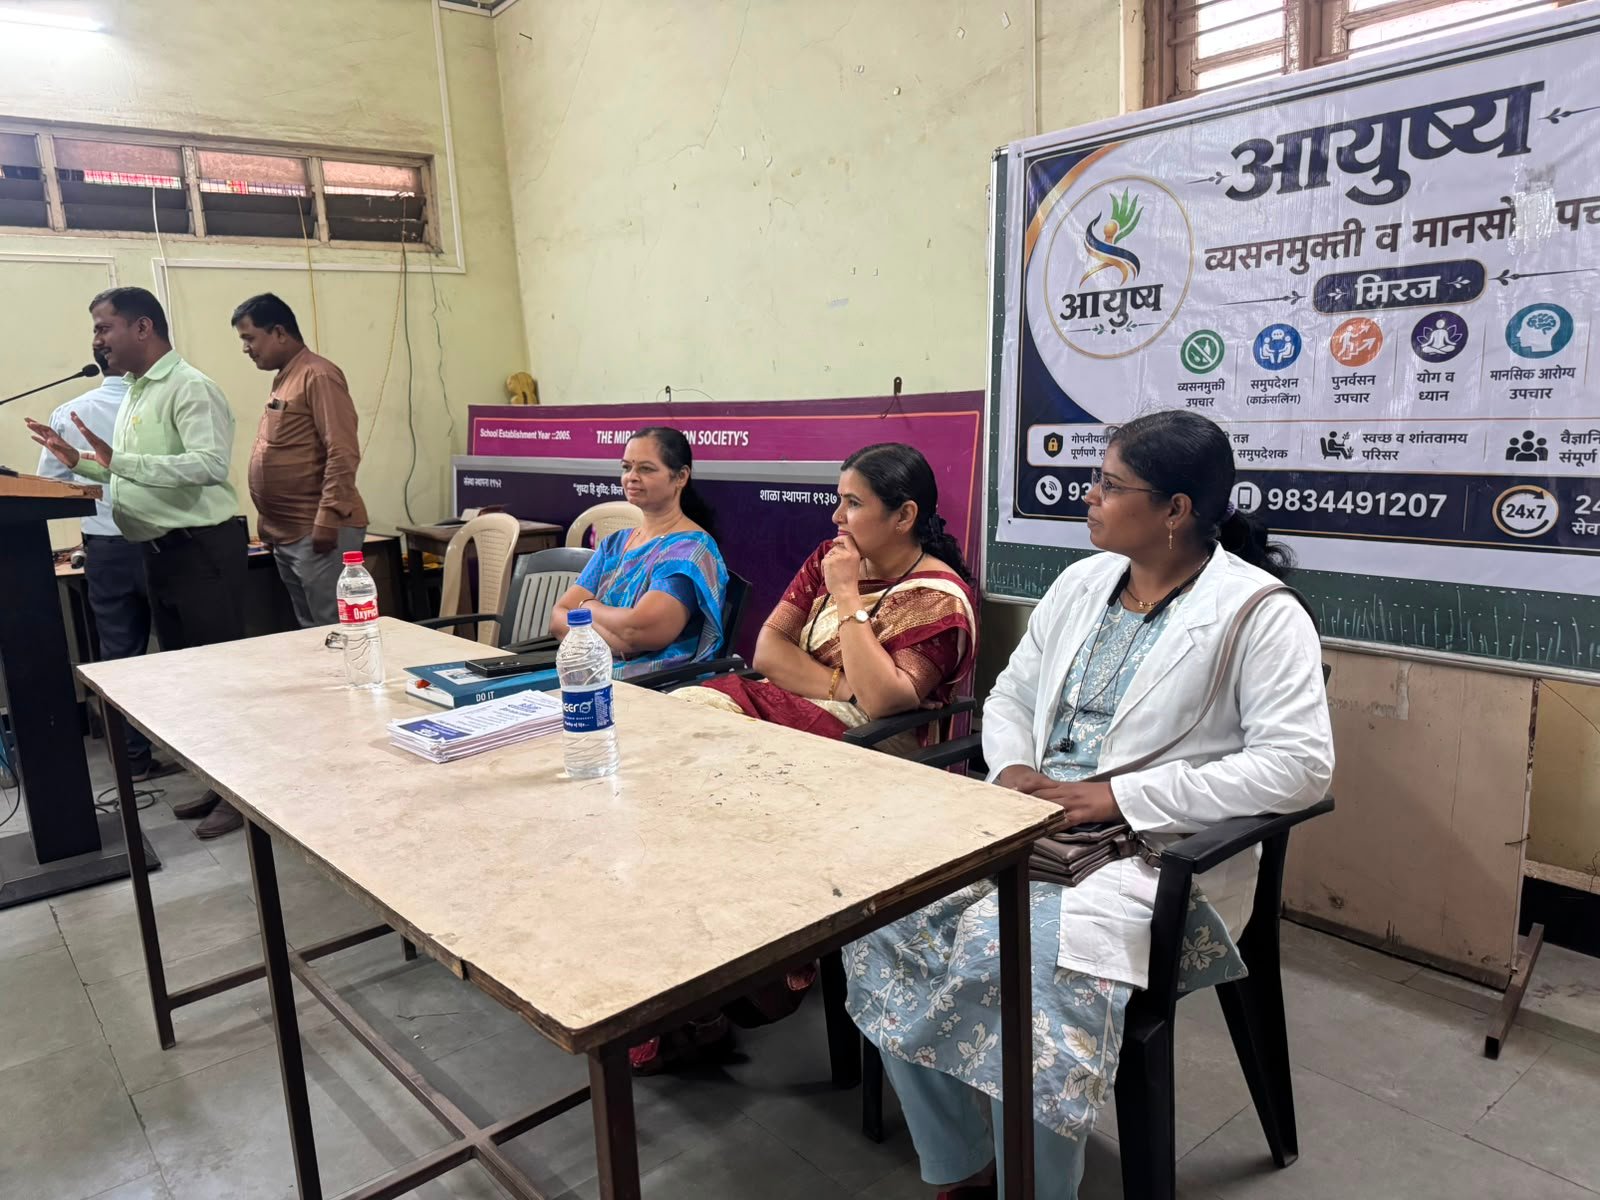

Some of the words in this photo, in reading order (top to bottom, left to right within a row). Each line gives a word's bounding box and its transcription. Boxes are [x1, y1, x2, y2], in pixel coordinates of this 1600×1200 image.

[1225, 81, 1546, 204] आयुष्य
[1205, 217, 1362, 274] व्यसनमुक्ती
[1375, 222, 1399, 254] व
[1355, 275, 1441, 309] मिरज
[1060, 282, 1163, 326] आयुष्य
[1416, 369, 1441, 384] योग
[1445, 371, 1456, 383] व
[1489, 366, 1536, 382] मानसिक
[1537, 364, 1577, 380] आरोग्य
[1177, 378, 1226, 394] व्यसनमुक्ती
[1250, 376, 1300, 392] समुपदेशन
[1331, 372, 1377, 390] पुनर्वसन
[1334, 391, 1371, 404] उपचार
[1418, 389, 1450, 402] ध्यान
[1509, 386, 1554, 400] उपचार
[1186, 396, 1215, 408] उपचार
[480, 428, 499, 438] School
[499, 428, 537, 439] Establishment
[537, 430, 551, 440] Year
[596, 430, 613, 444] THE
[697, 430, 750, 446] SOCIETY'S
[1233, 433, 1249, 445] तज्ञ
[1362, 433, 1393, 444] स्वच्छ
[1396, 433, 1405, 444] व
[1070, 446, 1097, 461] पूर्णपणे
[1237, 446, 1289, 461] समुपदेशक
[1361, 446, 1400, 461] परिसर
[760, 489, 780, 502] शाळा
[782, 490, 811, 503] स्थापना
[812, 492, 838, 506] १९३७
[1267, 488, 1448, 518] 9834491207
[1505, 503, 1547, 520] 24x7
[475, 692, 487, 703] DO
[488, 690, 495, 700] IT
